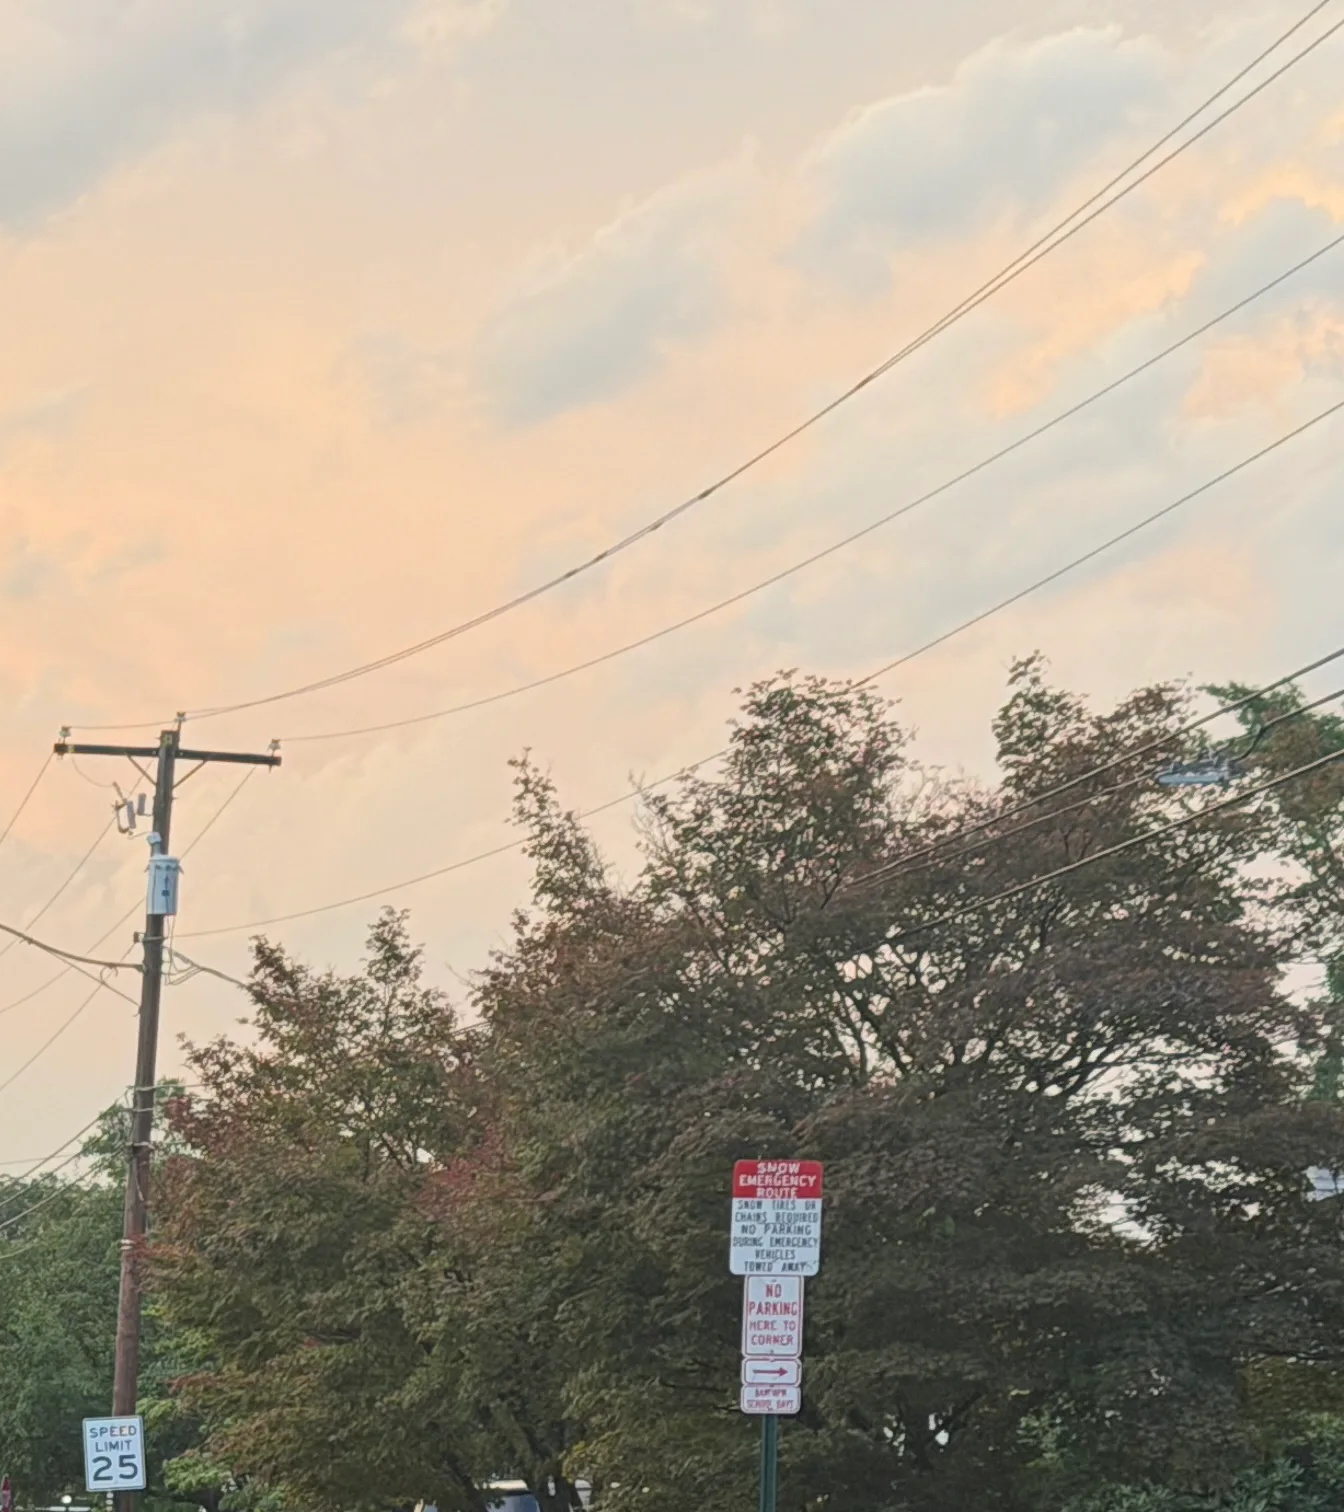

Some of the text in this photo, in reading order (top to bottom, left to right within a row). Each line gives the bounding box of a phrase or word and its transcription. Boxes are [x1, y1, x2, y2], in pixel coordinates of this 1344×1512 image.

[757, 1162, 801, 1174] SNOW
[739, 1174, 817, 1188] EMERGENCY
[756, 1187, 799, 1199] ROUTE
[737, 1200, 763, 1210] SNOW
[735, 1211, 819, 1224] CHAINS REQUIRED
[740, 1223, 812, 1236] NO PARKING
[732, 1236, 818, 1248] DURING EMERGENCY
[755, 1248, 796, 1260] VEHICLES
[744, 1261, 807, 1272] TOWED AWAY
[765, 1283, 782, 1298] NO
[748, 1301, 797, 1316] PARKING
[749, 1320, 797, 1331] HERE TO
[751, 1334, 794, 1346] CORNER
[89, 1425, 137, 1438] SPEED
[95, 1440, 133, 1453] LIMIT
[92, 1454, 139, 1481] 25
